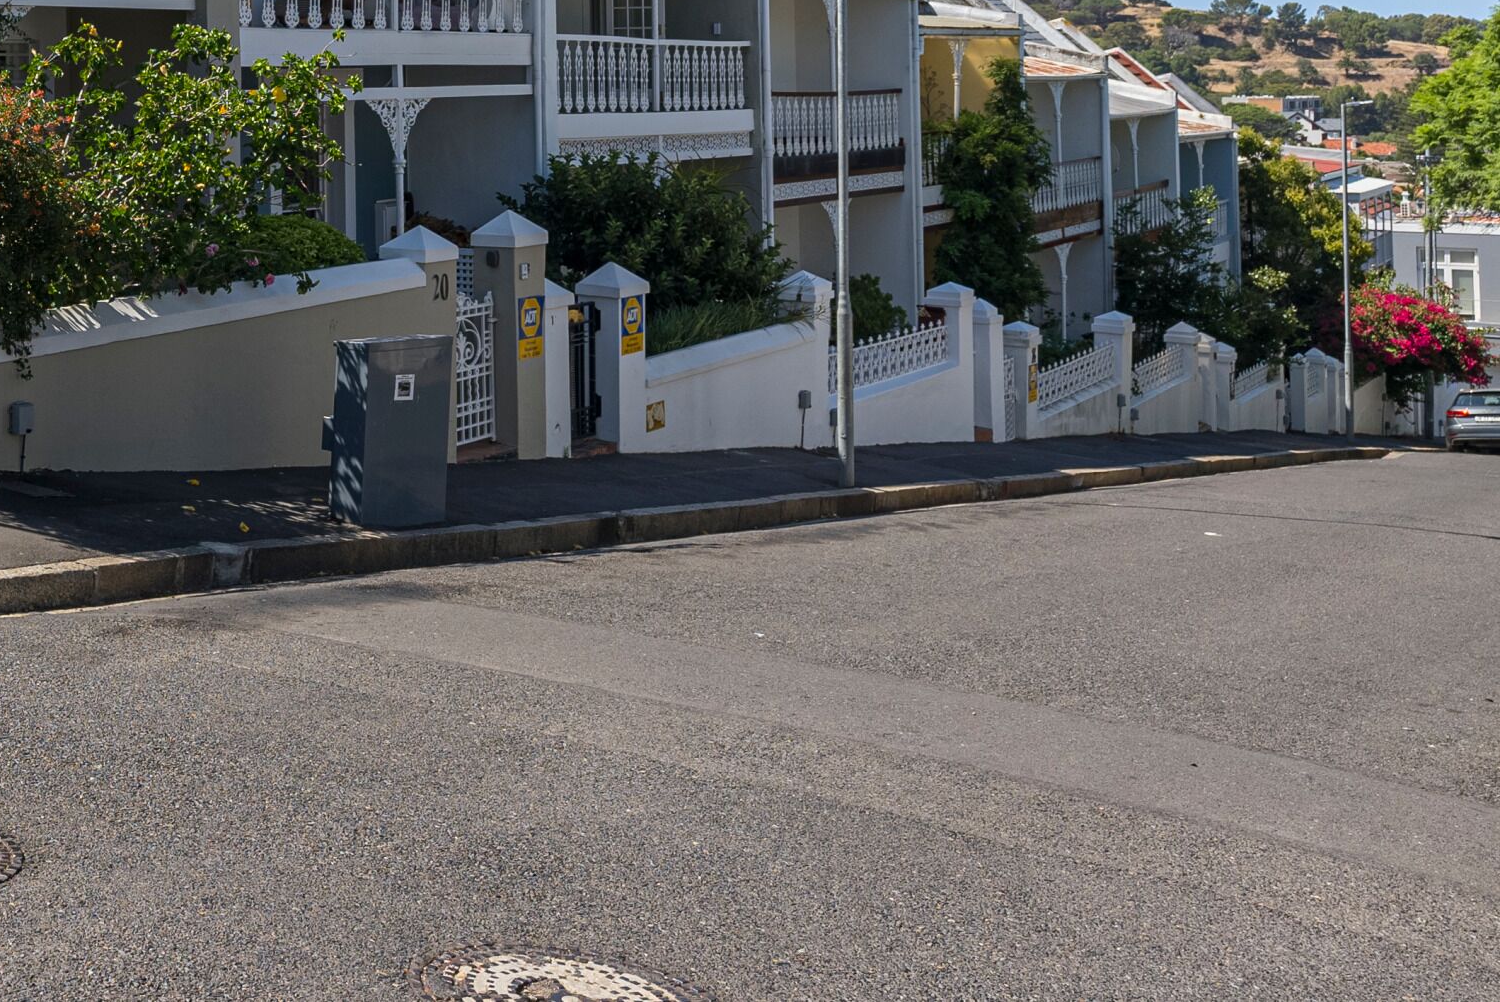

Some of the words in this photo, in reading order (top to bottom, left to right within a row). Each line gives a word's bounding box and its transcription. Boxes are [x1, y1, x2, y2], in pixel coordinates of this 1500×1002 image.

[432, 273, 449, 301] 20
[524, 310, 537, 325] ADT
[626, 307, 639, 322] ADT
